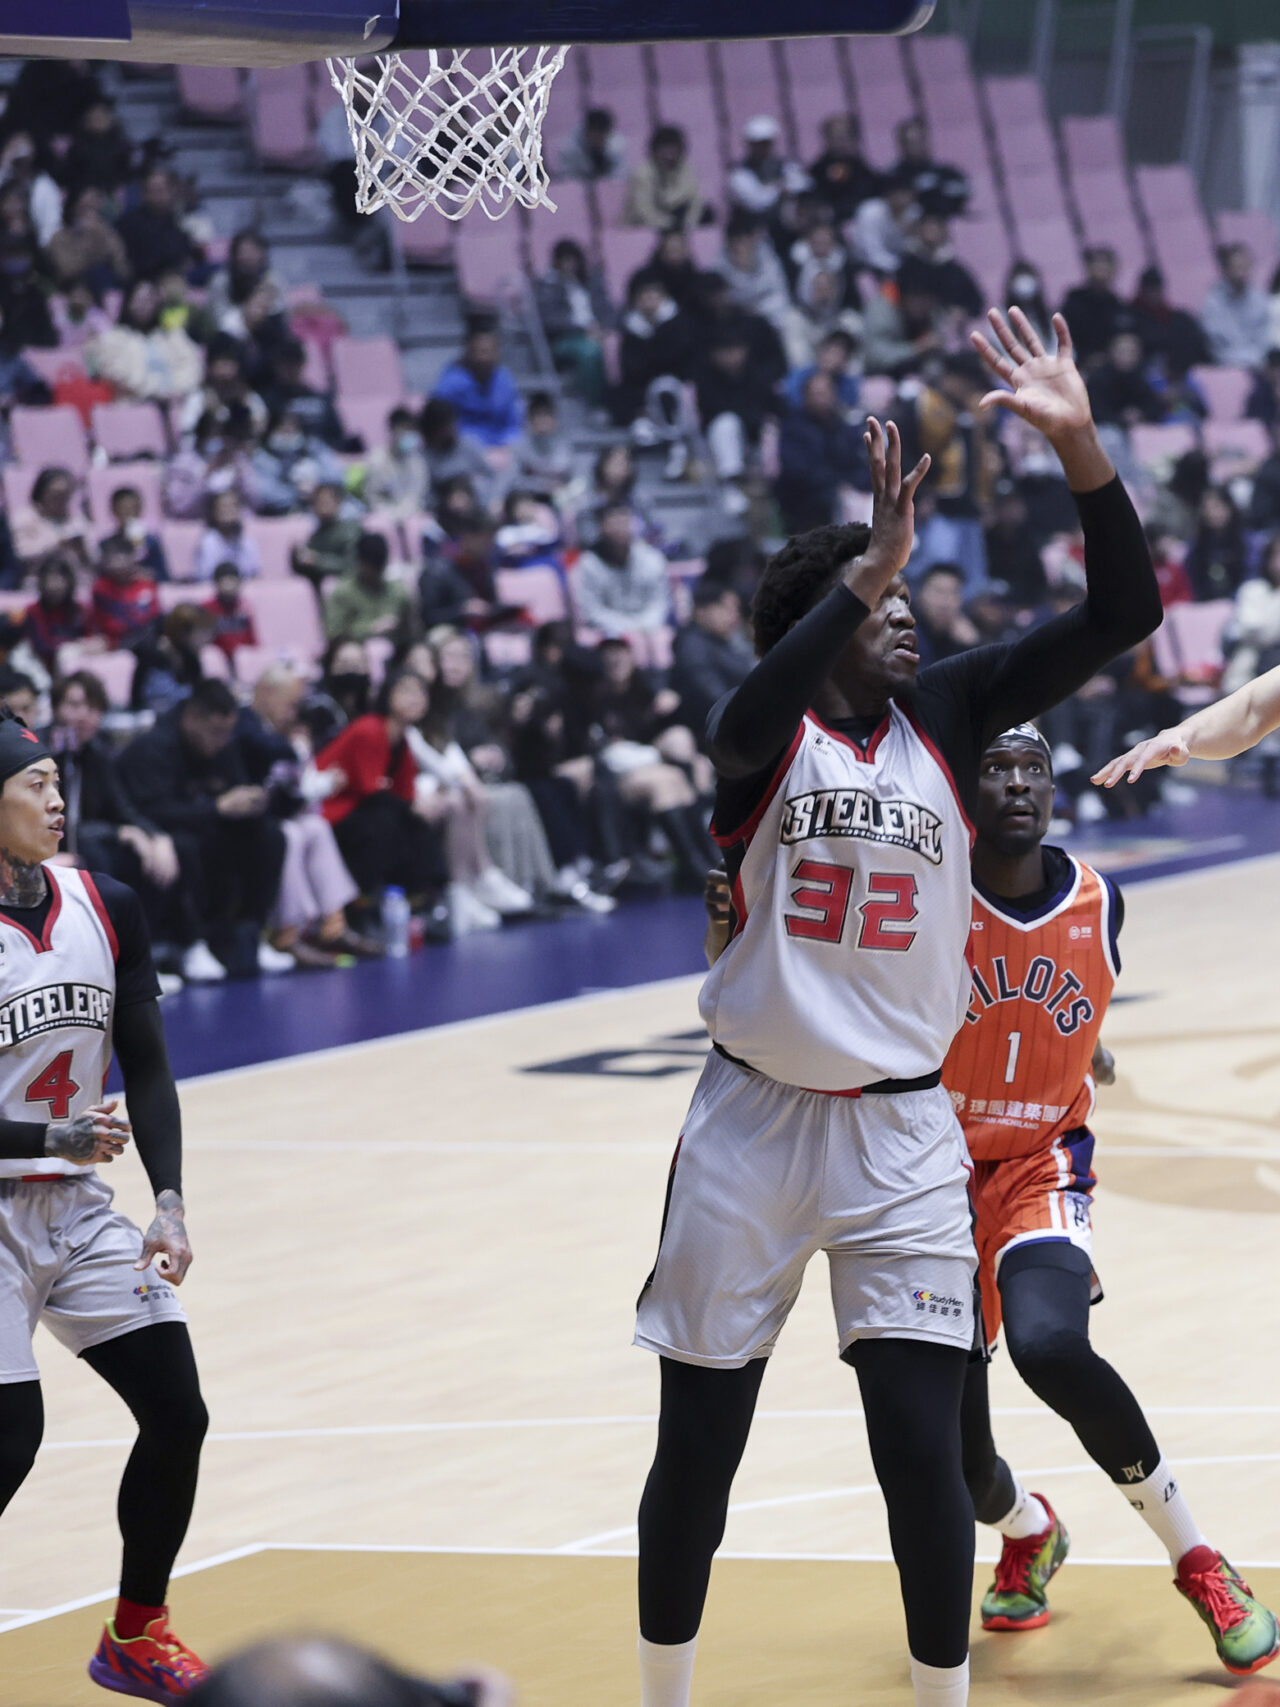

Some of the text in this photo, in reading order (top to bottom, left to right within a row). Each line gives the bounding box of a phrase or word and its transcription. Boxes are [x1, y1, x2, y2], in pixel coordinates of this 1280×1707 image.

[781, 789, 944, 865] STEELERS
[784, 859, 919, 951] 32
[25, 1050, 80, 1119] 4
[1004, 1031, 1022, 1084] 1
